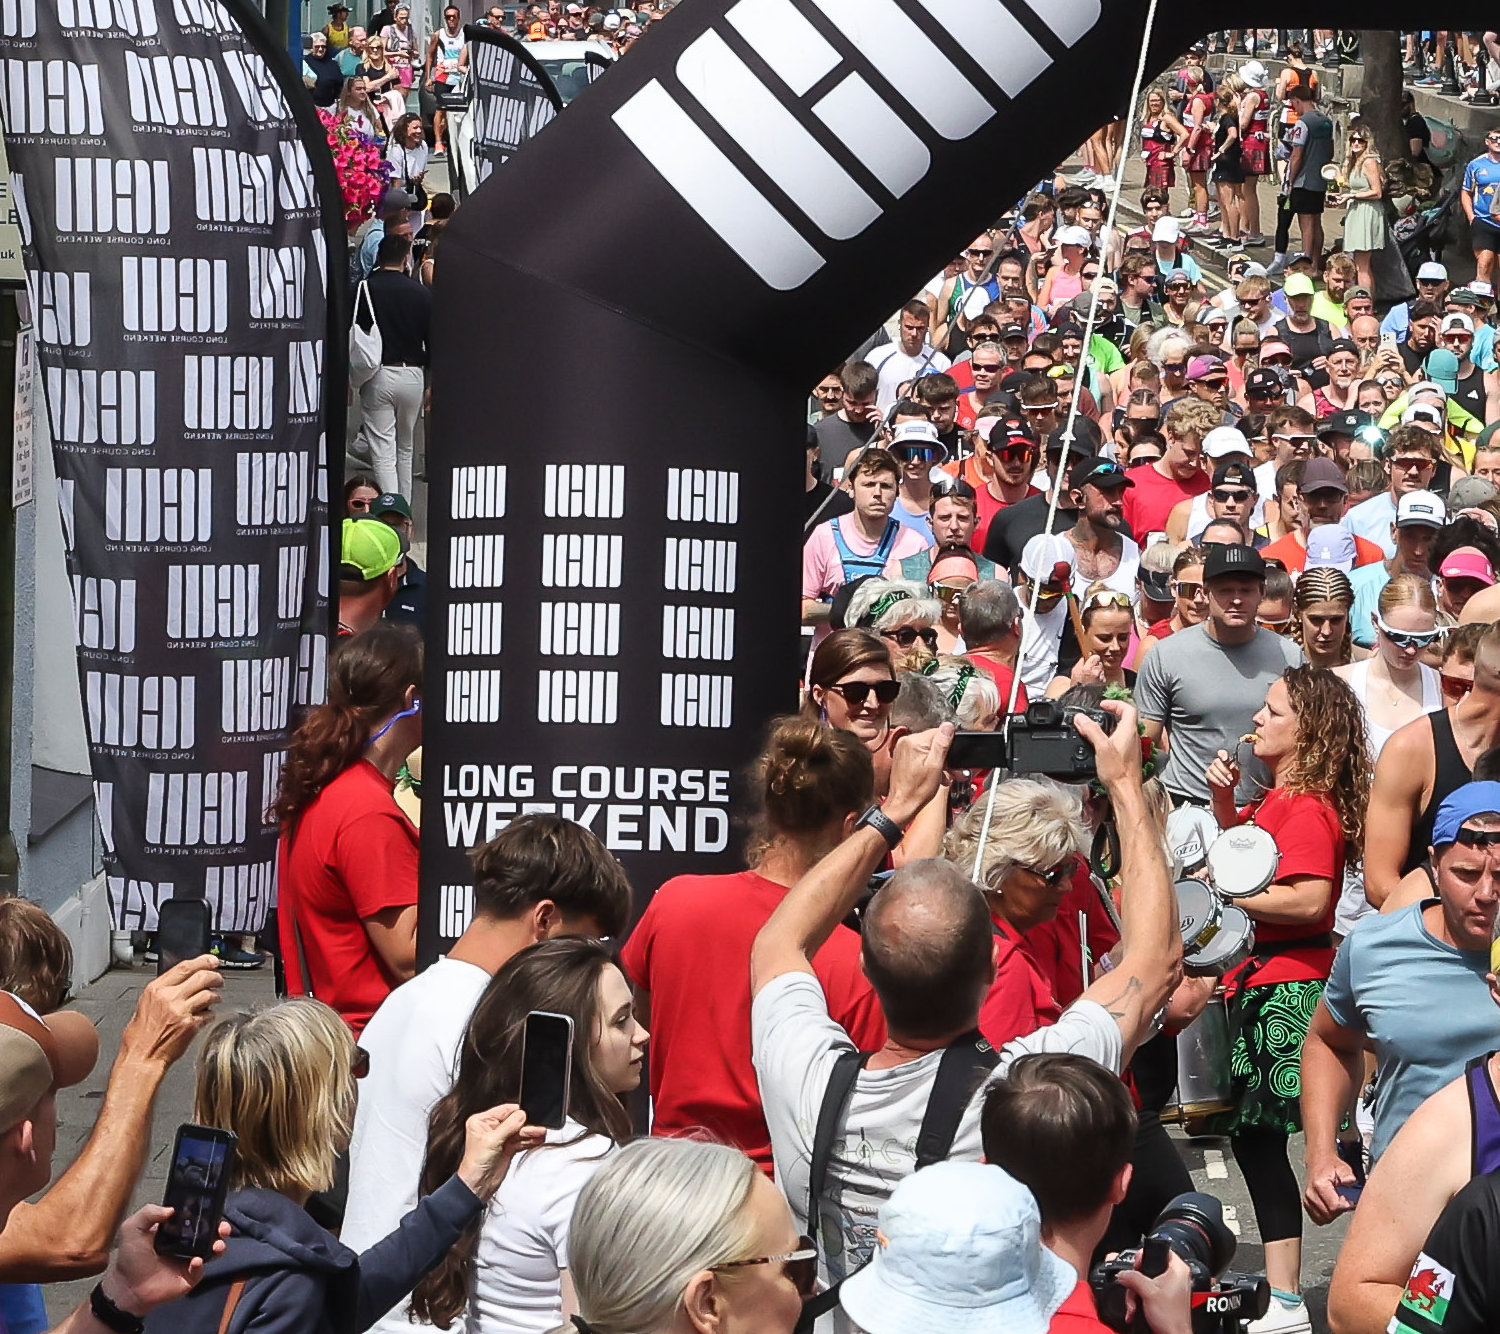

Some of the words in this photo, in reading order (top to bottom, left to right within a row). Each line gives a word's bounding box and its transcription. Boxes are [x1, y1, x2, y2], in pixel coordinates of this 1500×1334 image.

[444, 765, 535, 798] LONG
[552, 766, 730, 803] COURSE
[444, 802, 729, 853] WEKEND
